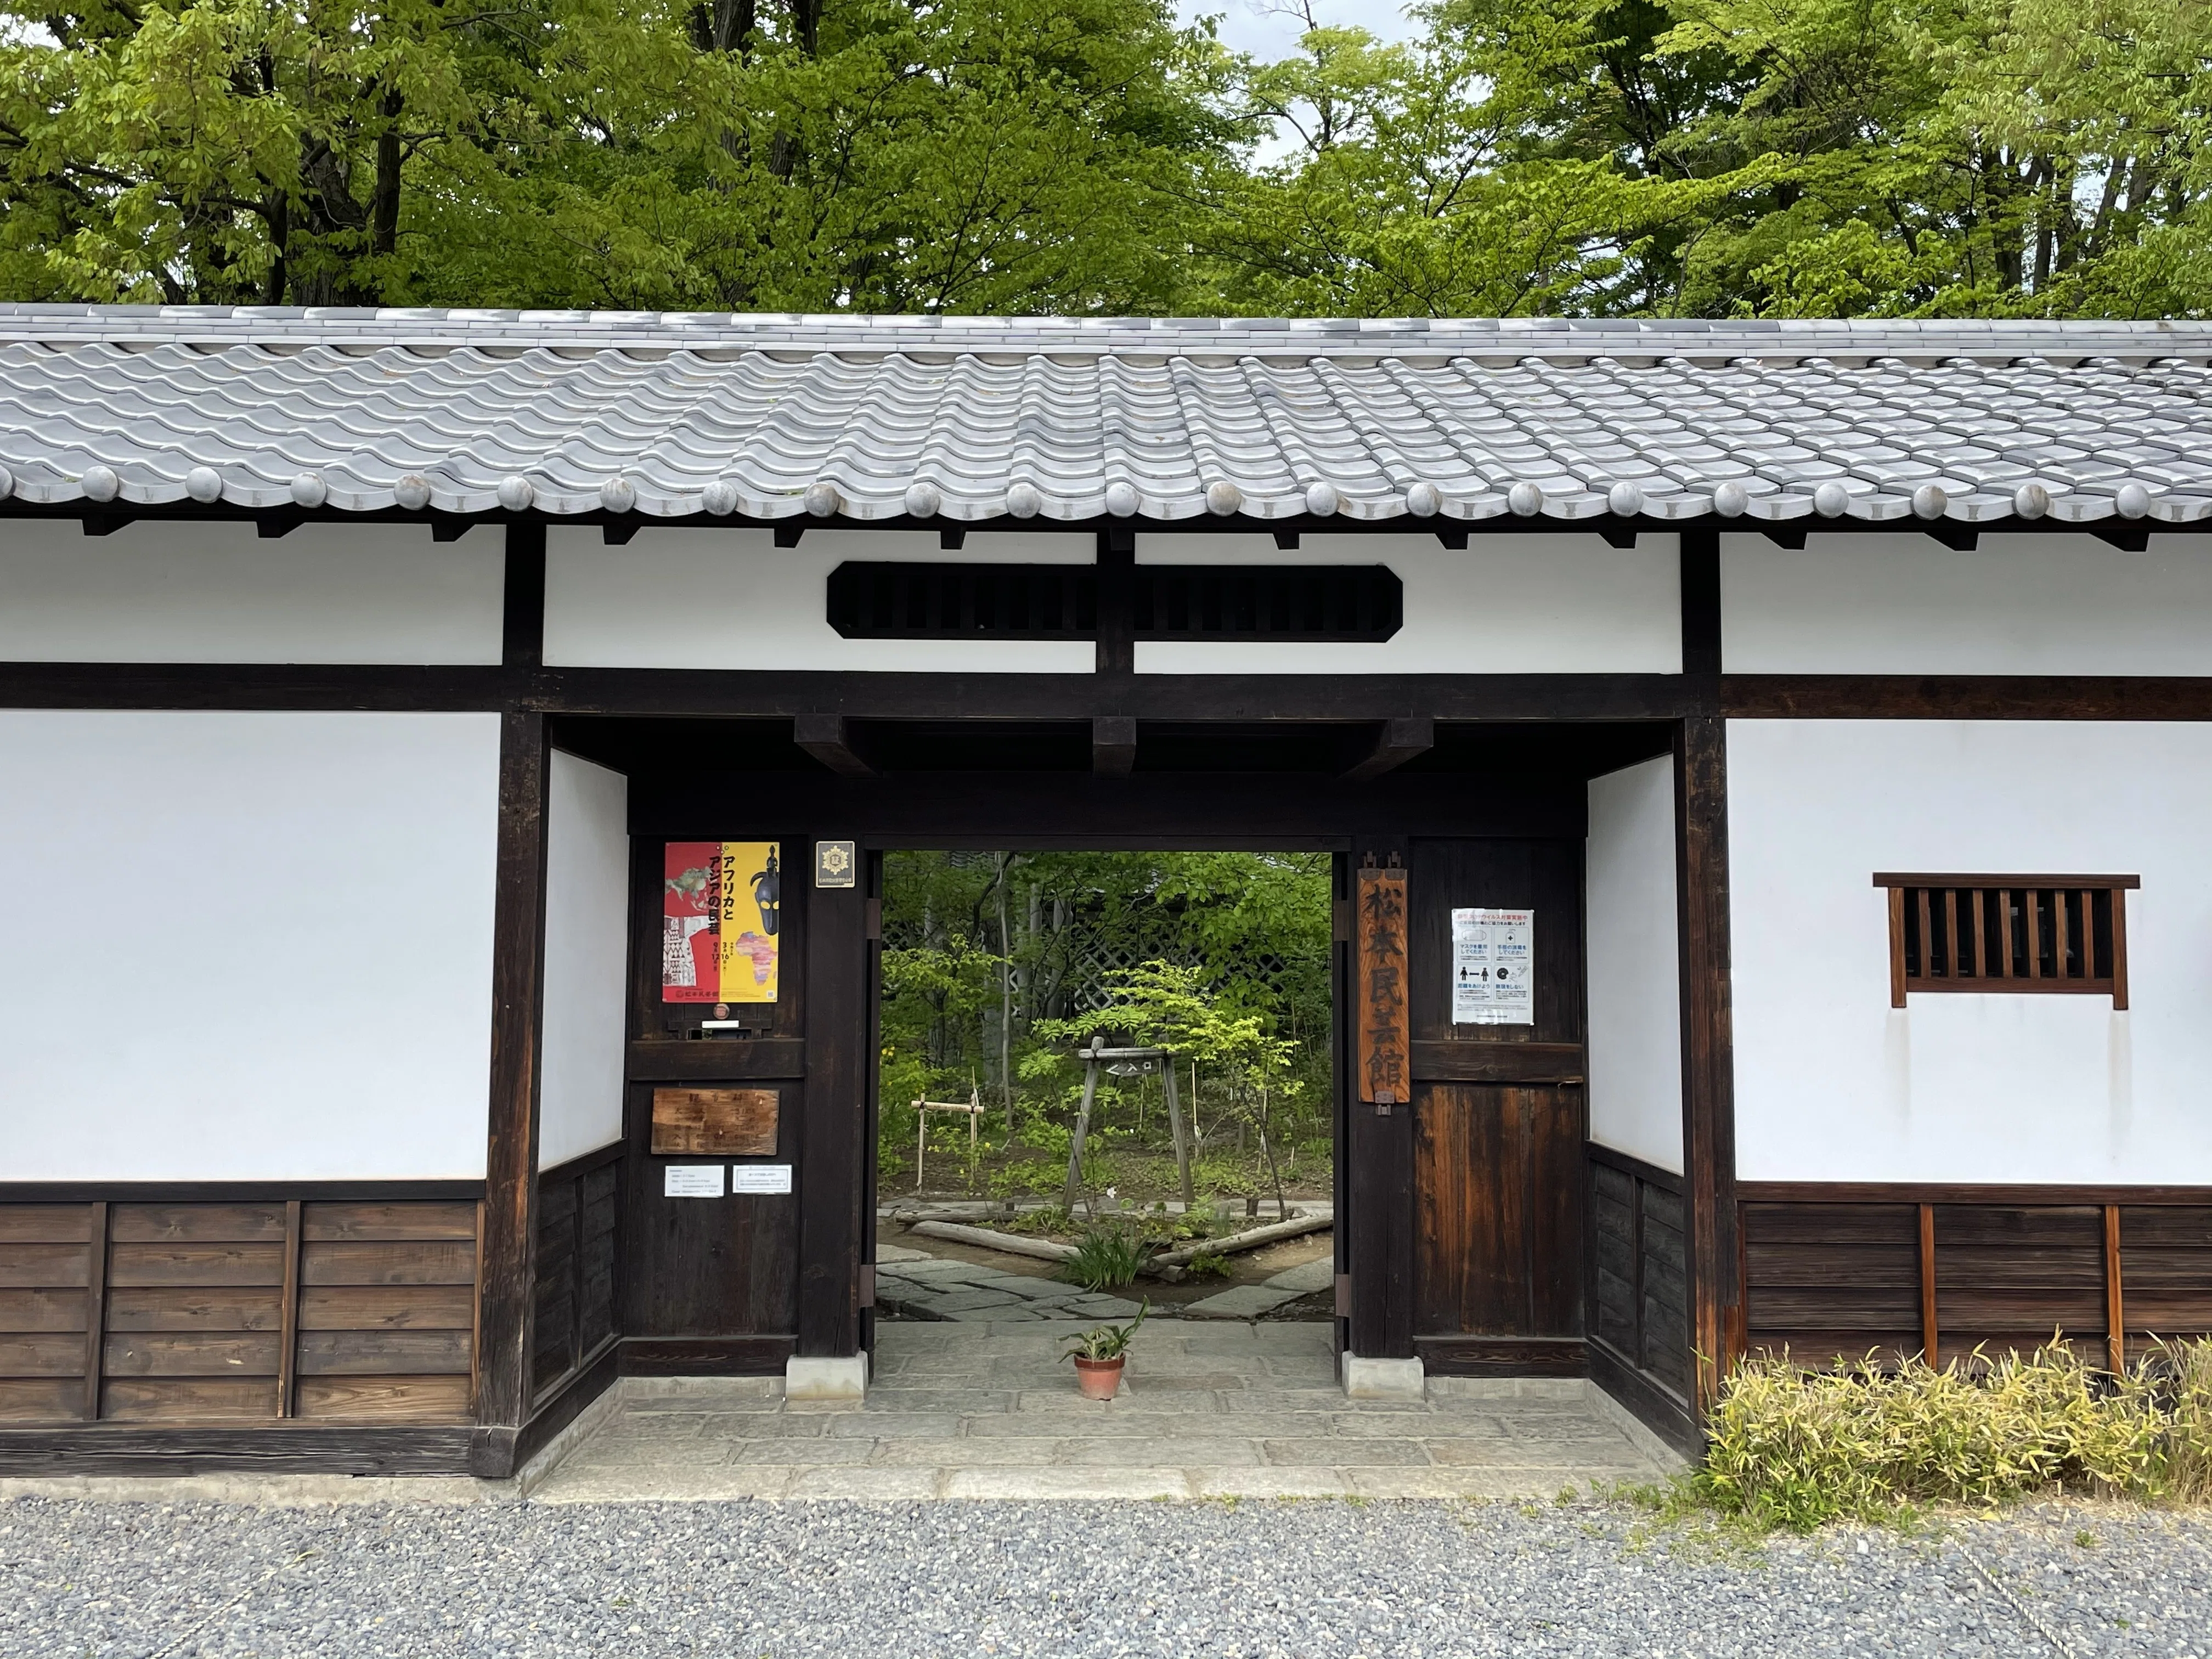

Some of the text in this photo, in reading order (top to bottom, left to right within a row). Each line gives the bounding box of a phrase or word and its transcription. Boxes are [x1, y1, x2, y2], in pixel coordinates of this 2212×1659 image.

[723, 856, 736, 920] アフリカと
[1127, 1062, 1152, 1072] 入口
